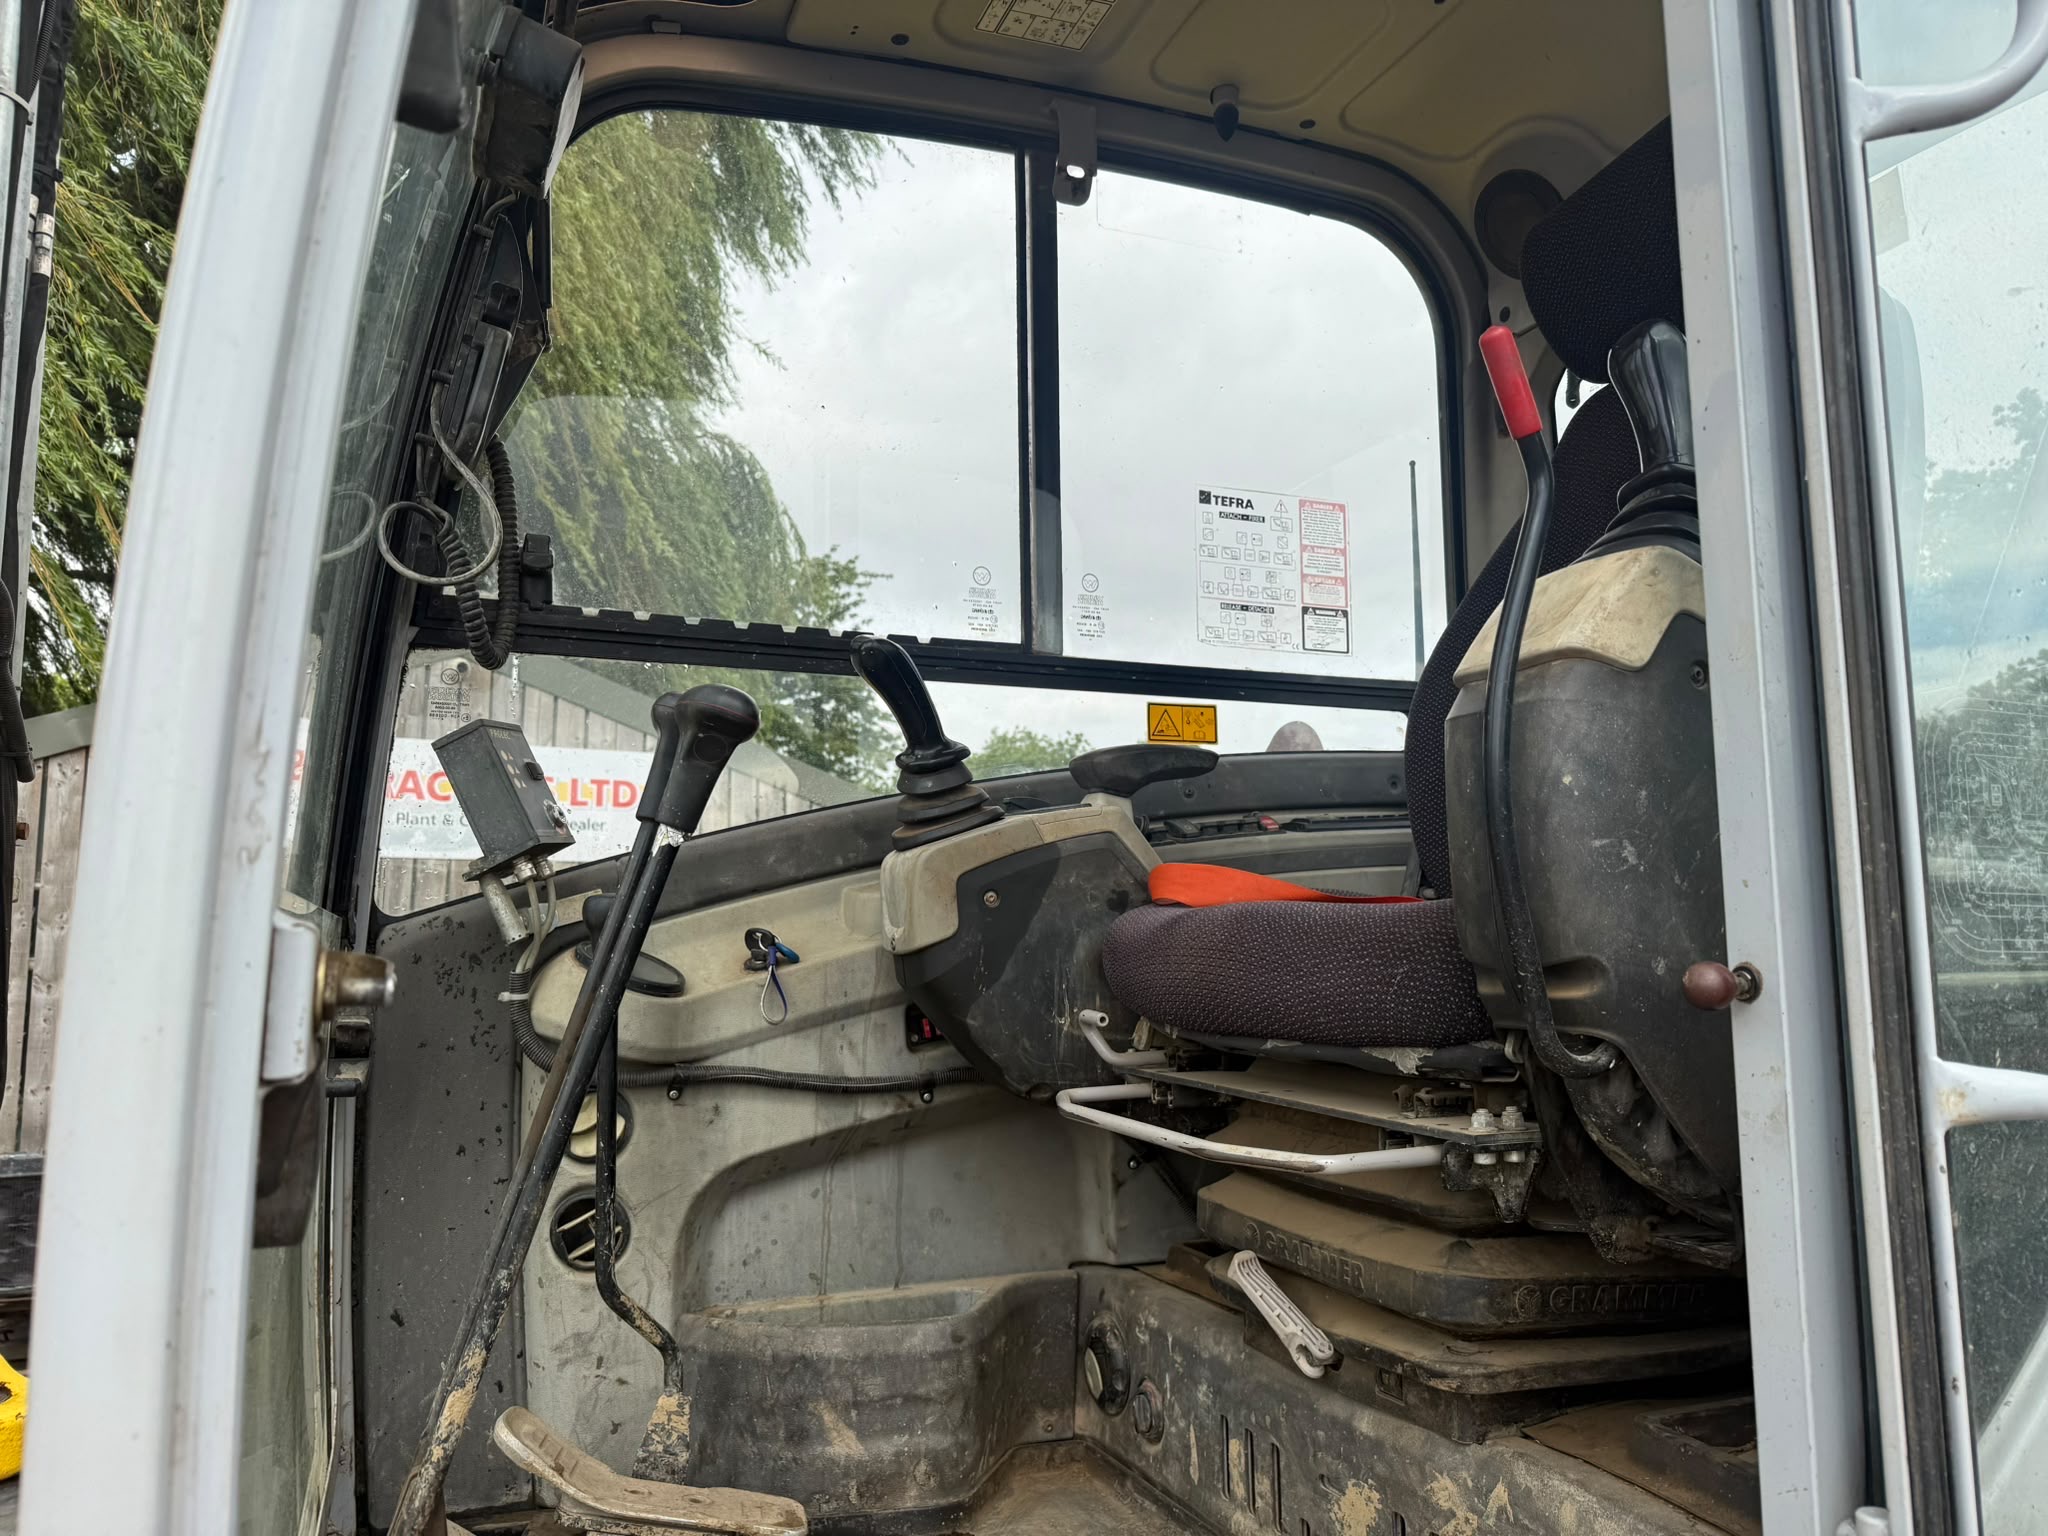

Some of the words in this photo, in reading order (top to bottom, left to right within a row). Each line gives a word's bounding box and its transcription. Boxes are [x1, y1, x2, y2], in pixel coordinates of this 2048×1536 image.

[1212, 494, 1255, 511] TEFRA
[1220, 512, 1242, 520] ATTACH
[1221, 603, 1242, 611] RELEASE
[1248, 605, 1274, 614] DETACHER
[570, 778, 638, 808] LTD
[396, 812, 437, 825] Plant
[442, 814, 454, 826] &
[569, 818, 606, 832] ealer
[1264, 1230, 1367, 1293] GRAMMER
